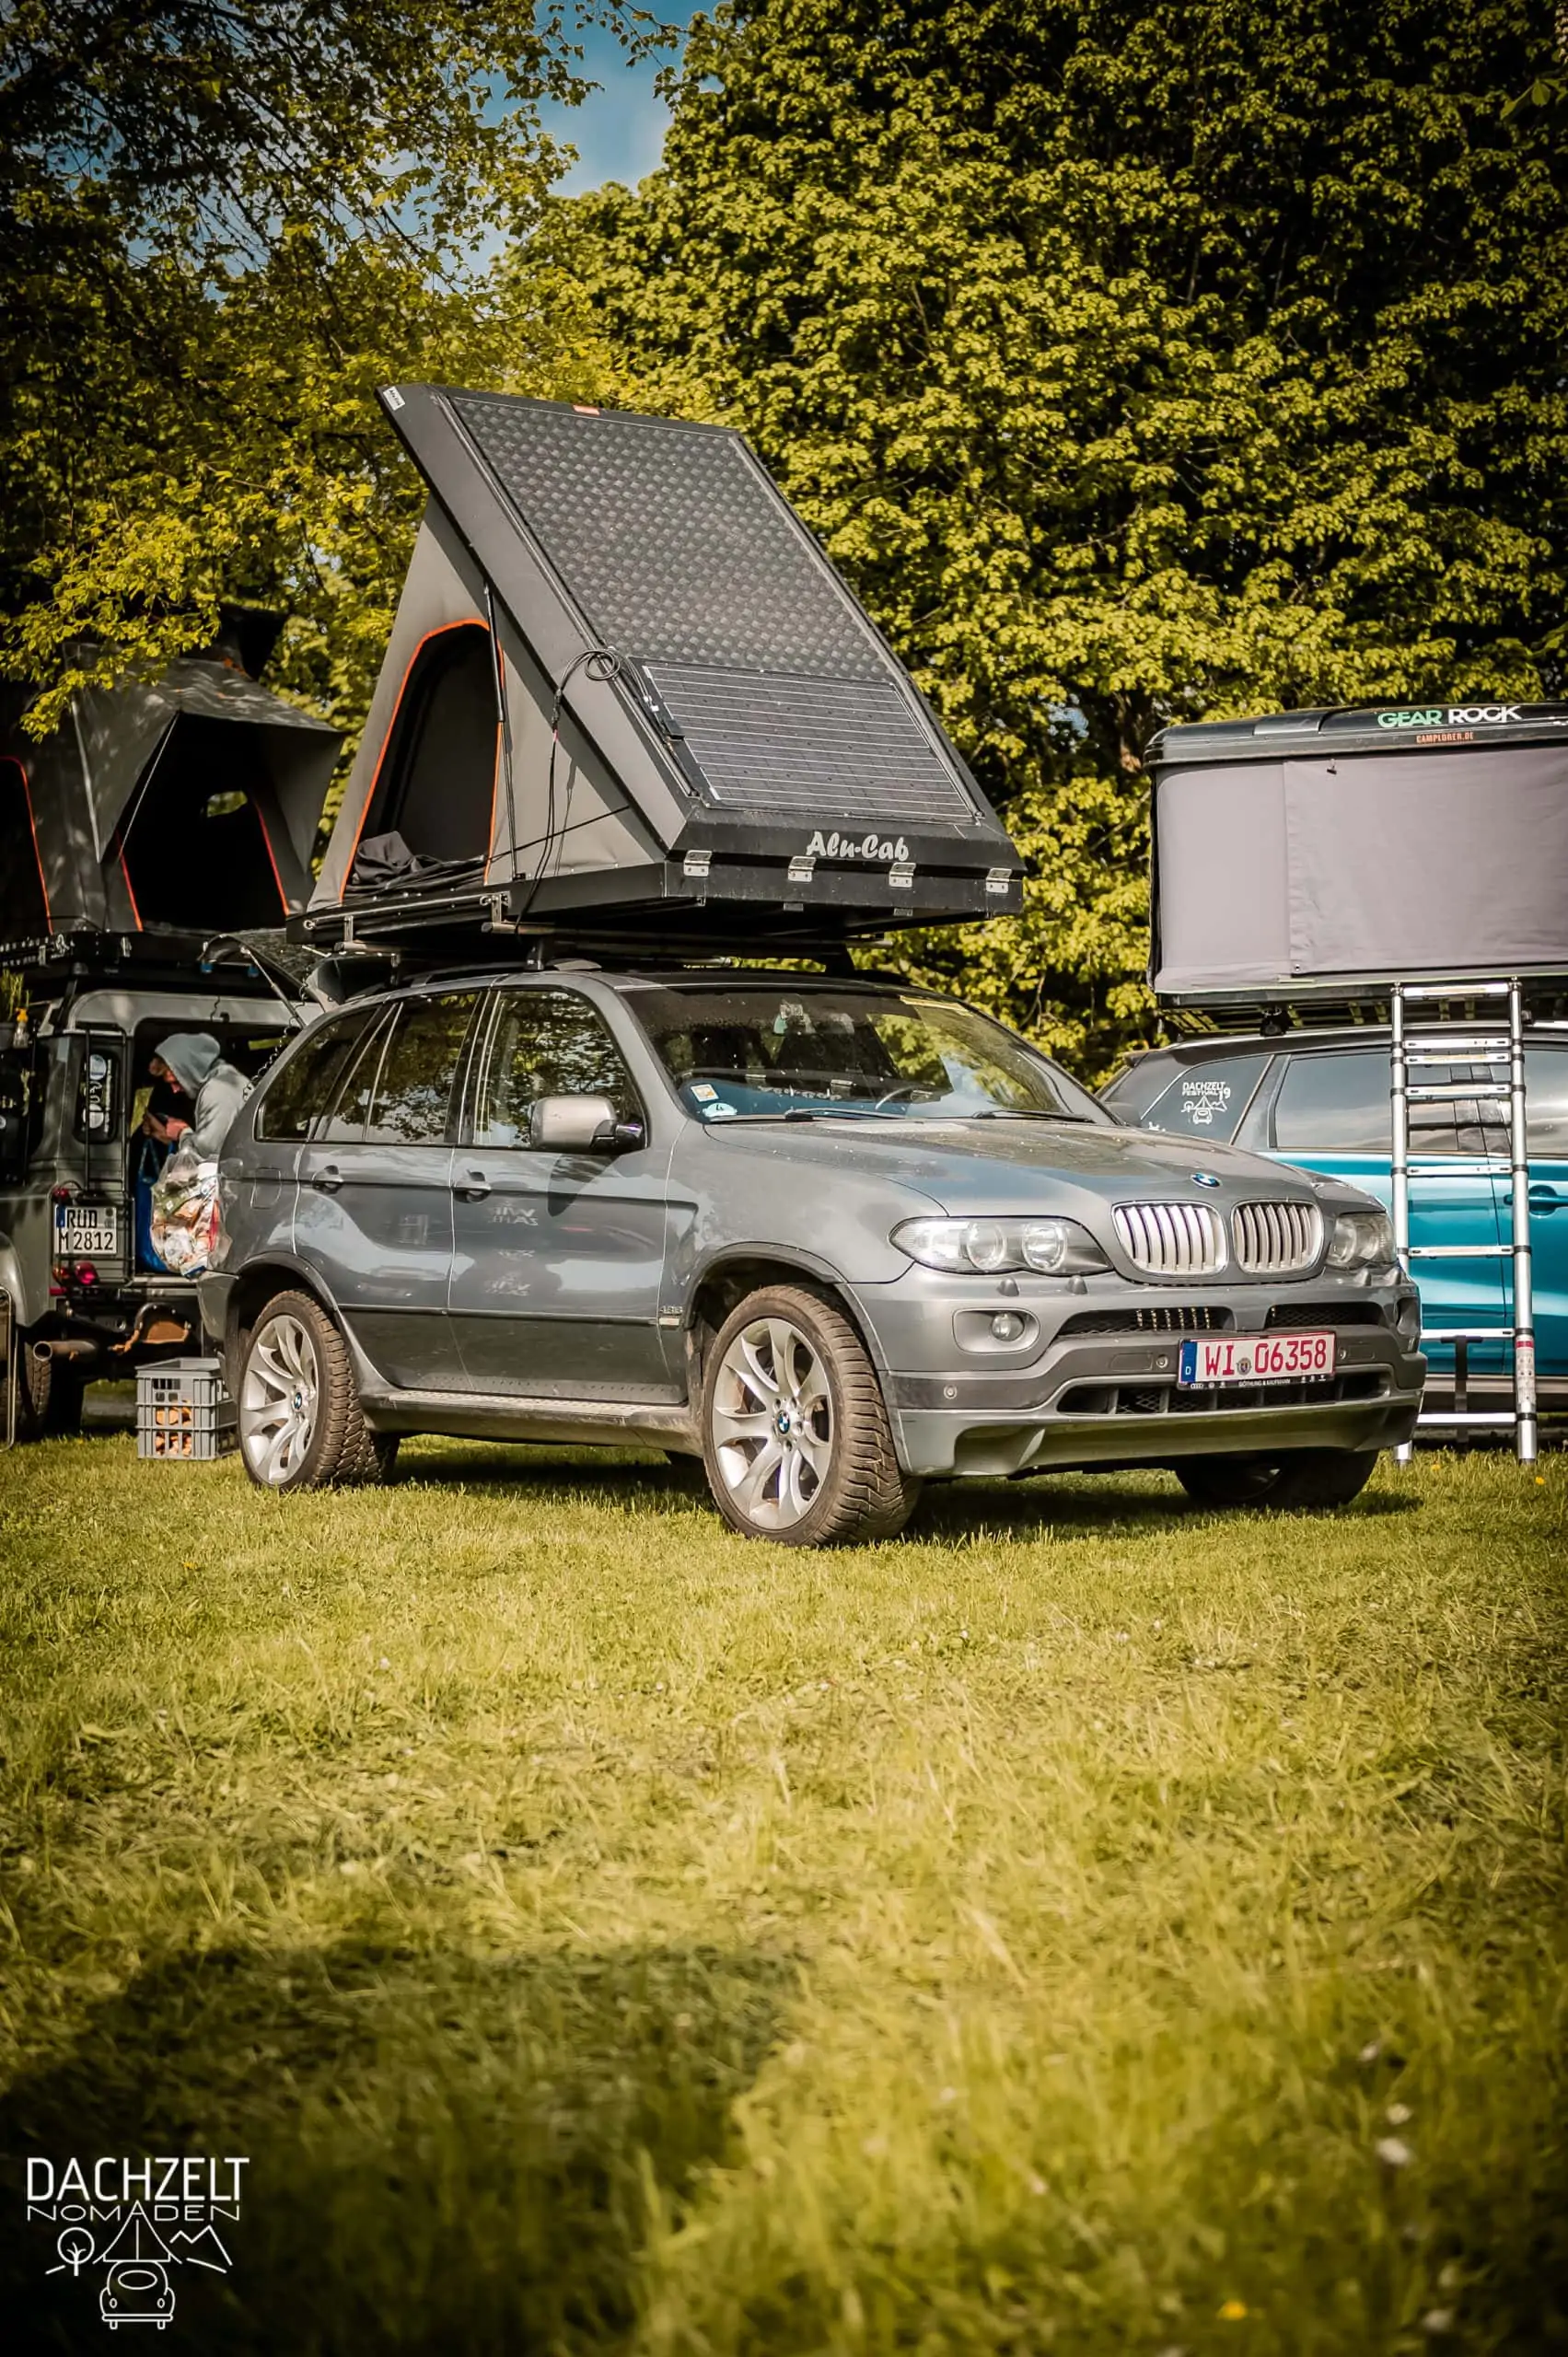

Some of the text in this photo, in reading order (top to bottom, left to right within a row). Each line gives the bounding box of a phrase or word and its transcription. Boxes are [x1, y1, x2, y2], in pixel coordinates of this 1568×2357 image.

[1377, 705, 1523, 728] GEAR ROCK
[806, 830, 910, 862] Alu-Cab
[1182, 1081, 1225, 1091] DACHZELT
[66, 1209, 98, 1229] RÜD
[58, 1230, 114, 1251] M 2812
[1205, 1339, 1327, 1376] WI 06358
[1185, 1366, 1191, 1376] D
